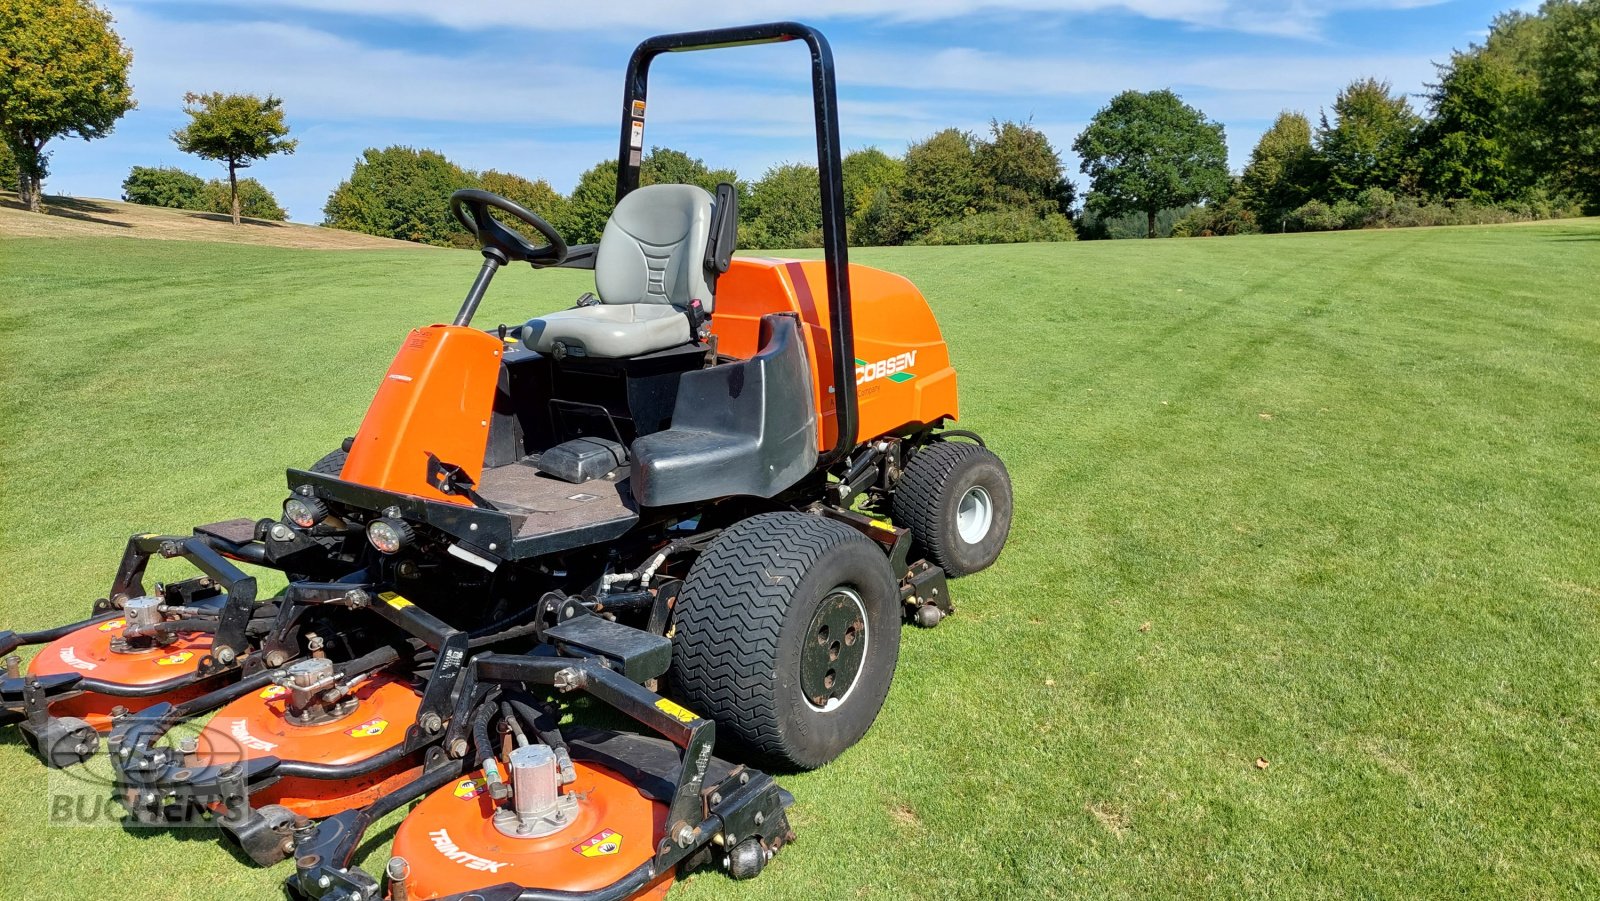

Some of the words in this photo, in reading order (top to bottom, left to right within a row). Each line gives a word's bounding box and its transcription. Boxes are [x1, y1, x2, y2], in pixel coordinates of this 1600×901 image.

[60, 646, 97, 670] TRIMTEK
[231, 719, 278, 751] TRIMTEK
[428, 828, 508, 873] TRIMTEK
